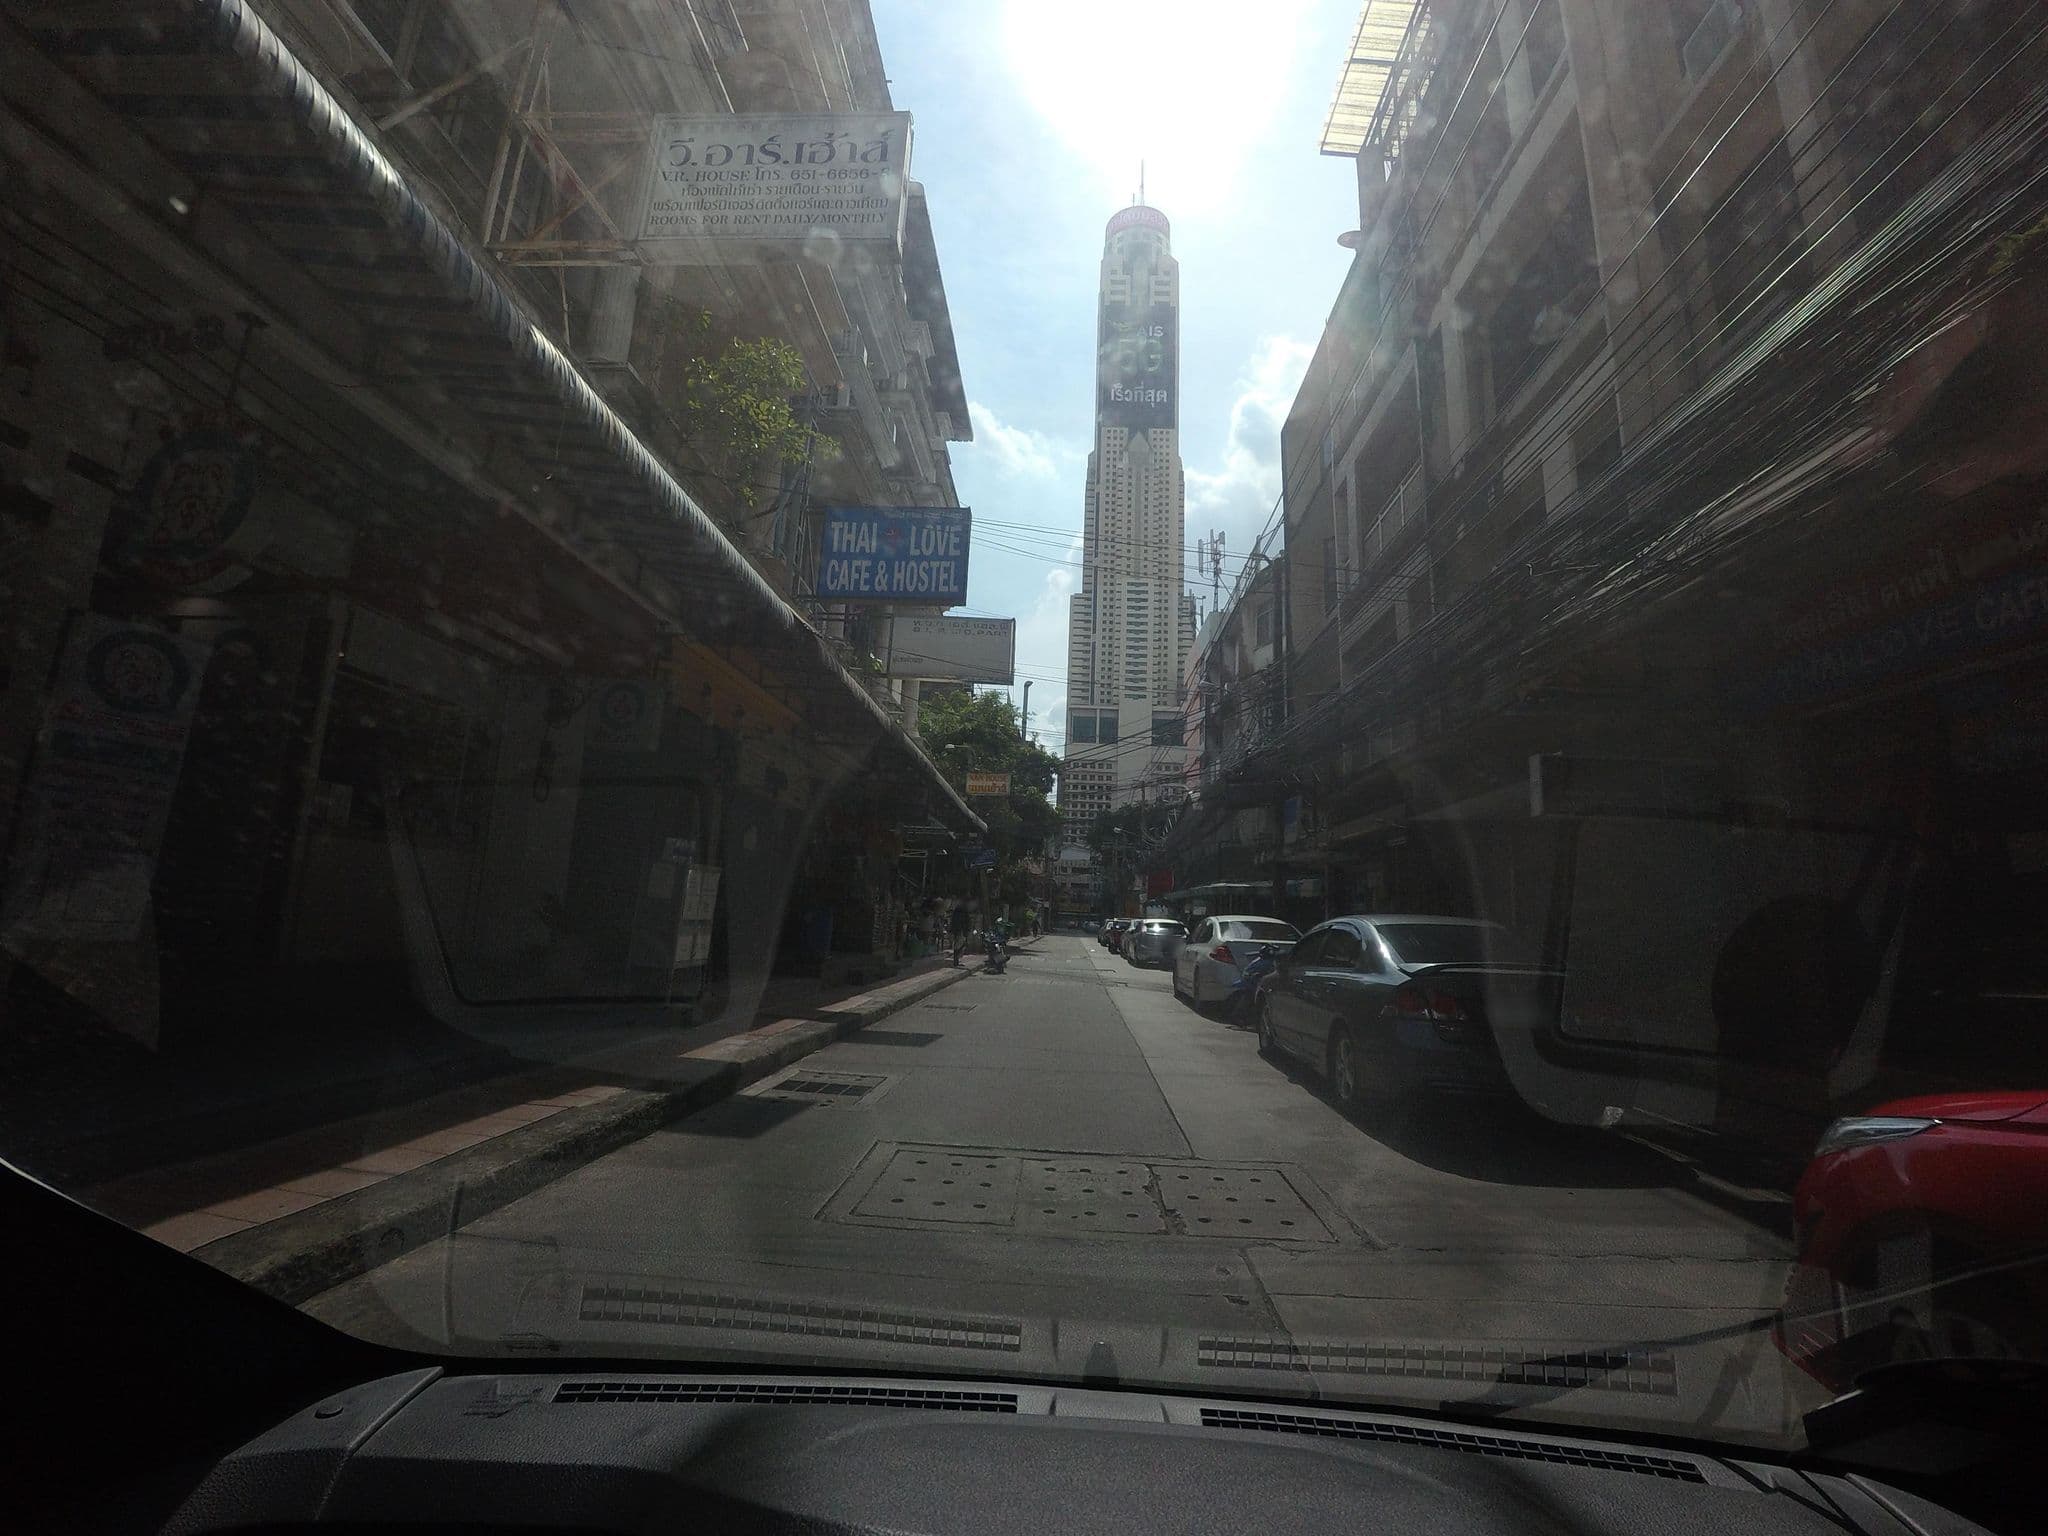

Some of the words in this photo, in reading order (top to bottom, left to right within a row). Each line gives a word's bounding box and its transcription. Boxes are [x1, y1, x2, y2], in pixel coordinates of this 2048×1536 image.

[669, 130, 896, 168] วี.อาร์.เฮ้าส์
[661, 169, 690, 183] V.R.
[695, 169, 750, 182] HOUSE
[650, 214, 698, 226] ROOMS
[702, 214, 729, 225] FOR
[733, 214, 771, 225] RENT
[831, 521, 877, 552] THAI
[909, 525, 963, 556] LOVE
[827, 560, 871, 592] CAFE
[874, 560, 888, 591] &
[893, 560, 959, 592] HOSTEL
